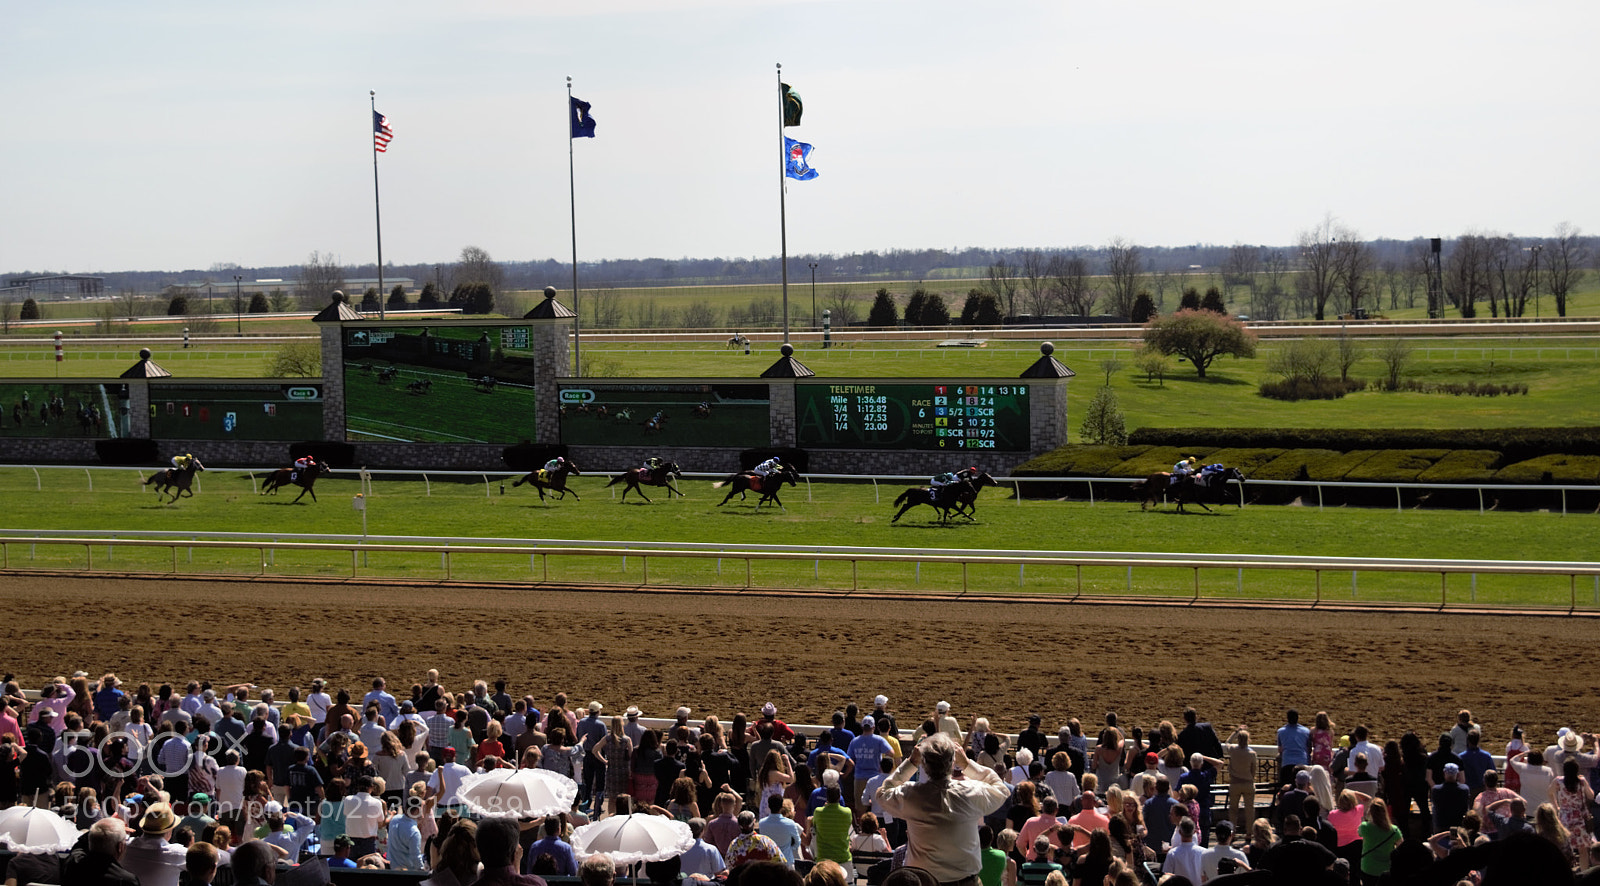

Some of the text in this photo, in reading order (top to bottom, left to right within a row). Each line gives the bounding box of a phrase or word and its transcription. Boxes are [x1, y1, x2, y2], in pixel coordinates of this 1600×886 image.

[830, 396, 887, 404] Mile 1:36.48
[919, 408, 925, 418] 6
[949, 408, 963, 416] 5/2
[981, 430, 994, 438] 9/2
